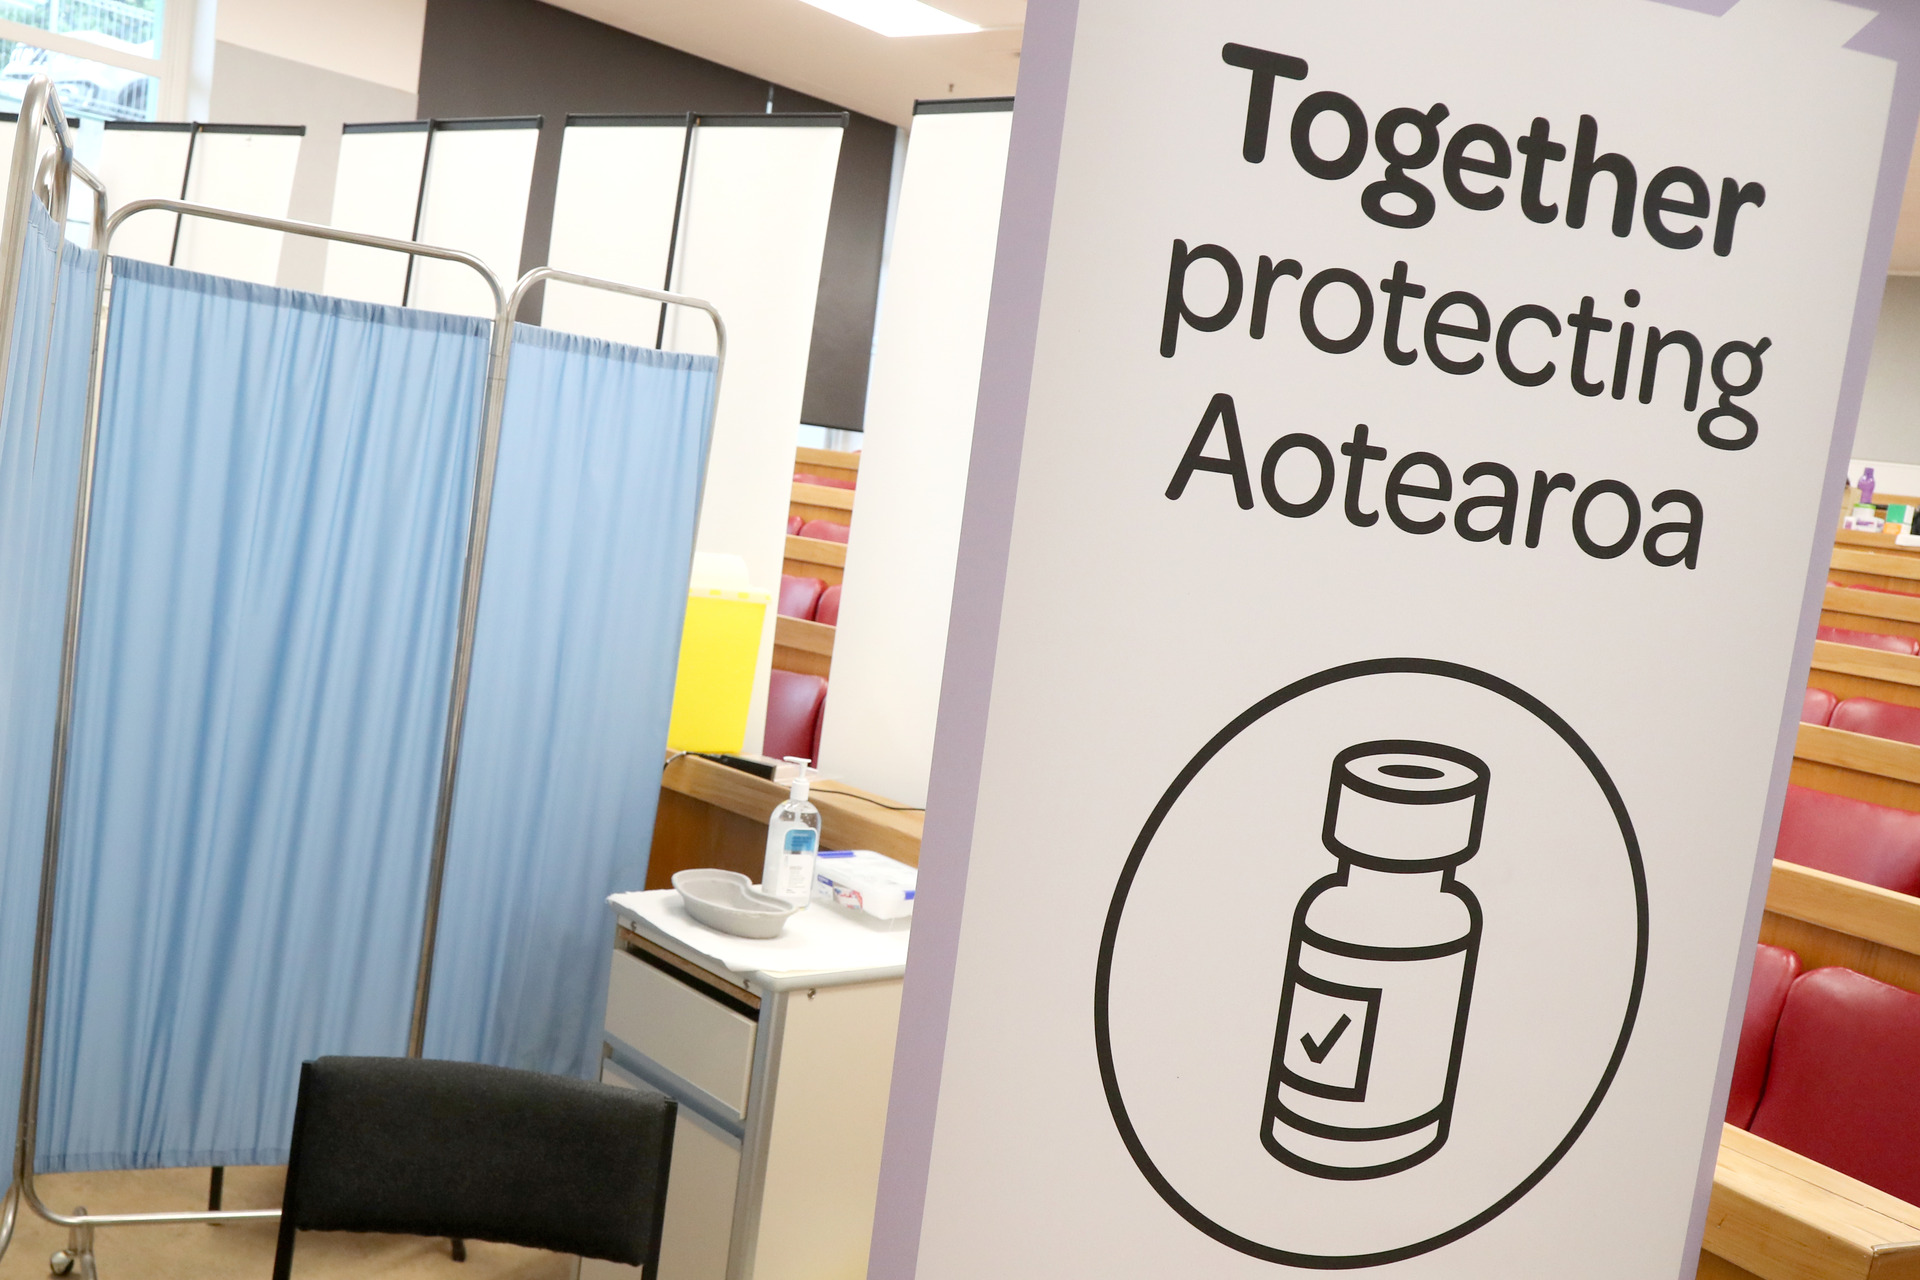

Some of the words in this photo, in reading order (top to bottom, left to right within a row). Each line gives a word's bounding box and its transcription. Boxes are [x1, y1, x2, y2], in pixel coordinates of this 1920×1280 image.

[1222, 43, 1766, 257] Together
[1160, 239, 1772, 451] protecting
[1165, 393, 1704, 570] Aotearoa
